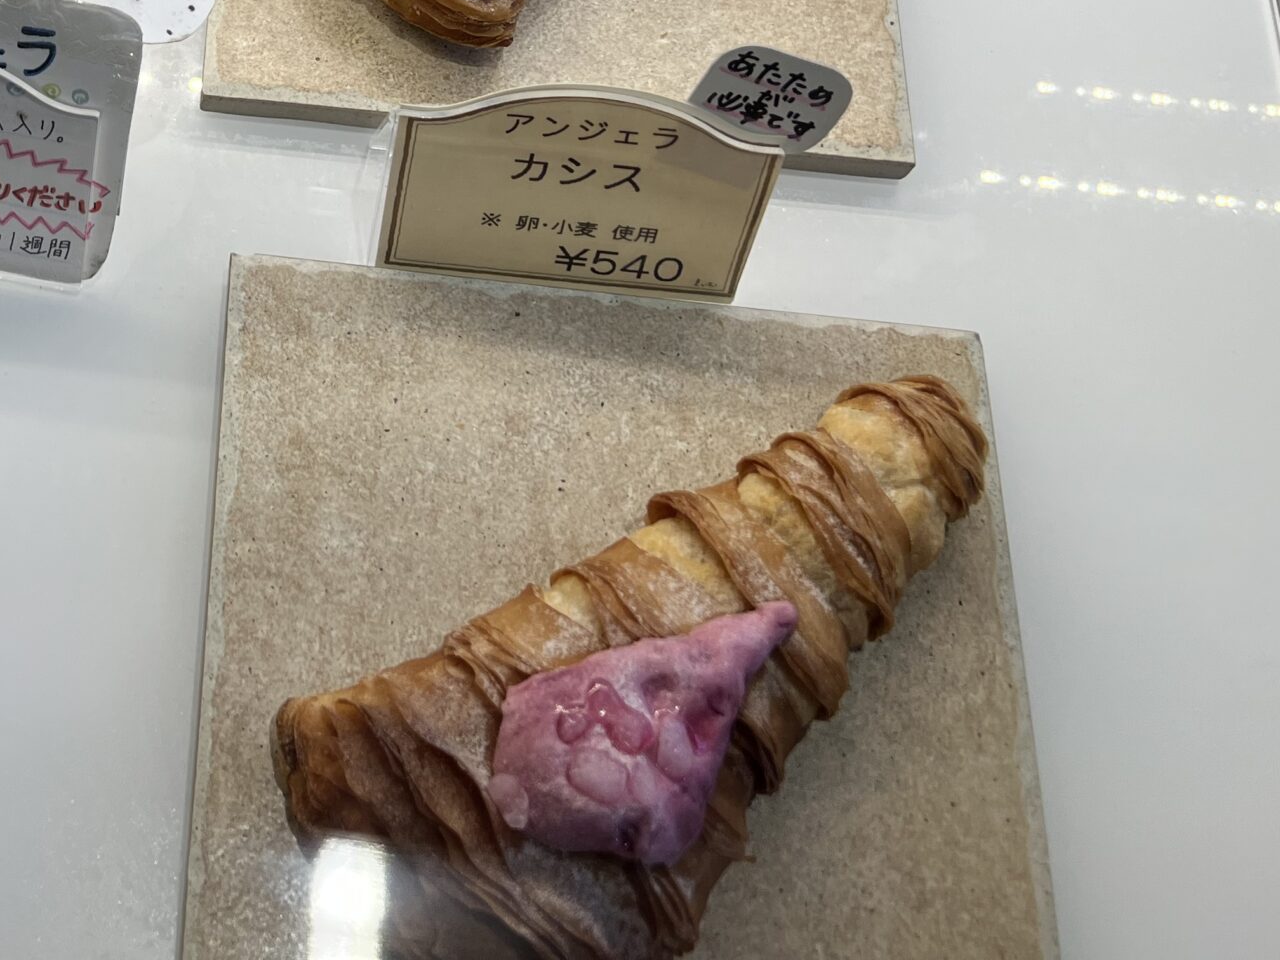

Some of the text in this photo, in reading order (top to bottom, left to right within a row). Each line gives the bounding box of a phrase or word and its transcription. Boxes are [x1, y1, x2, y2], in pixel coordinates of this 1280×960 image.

[727, 51, 834, 107] あたため
[503, 112, 681, 151] アンジェラ
[707, 91, 816, 139] 必要です
[510, 151, 642, 193] カシス
[554, 245, 685, 283] ¥540
